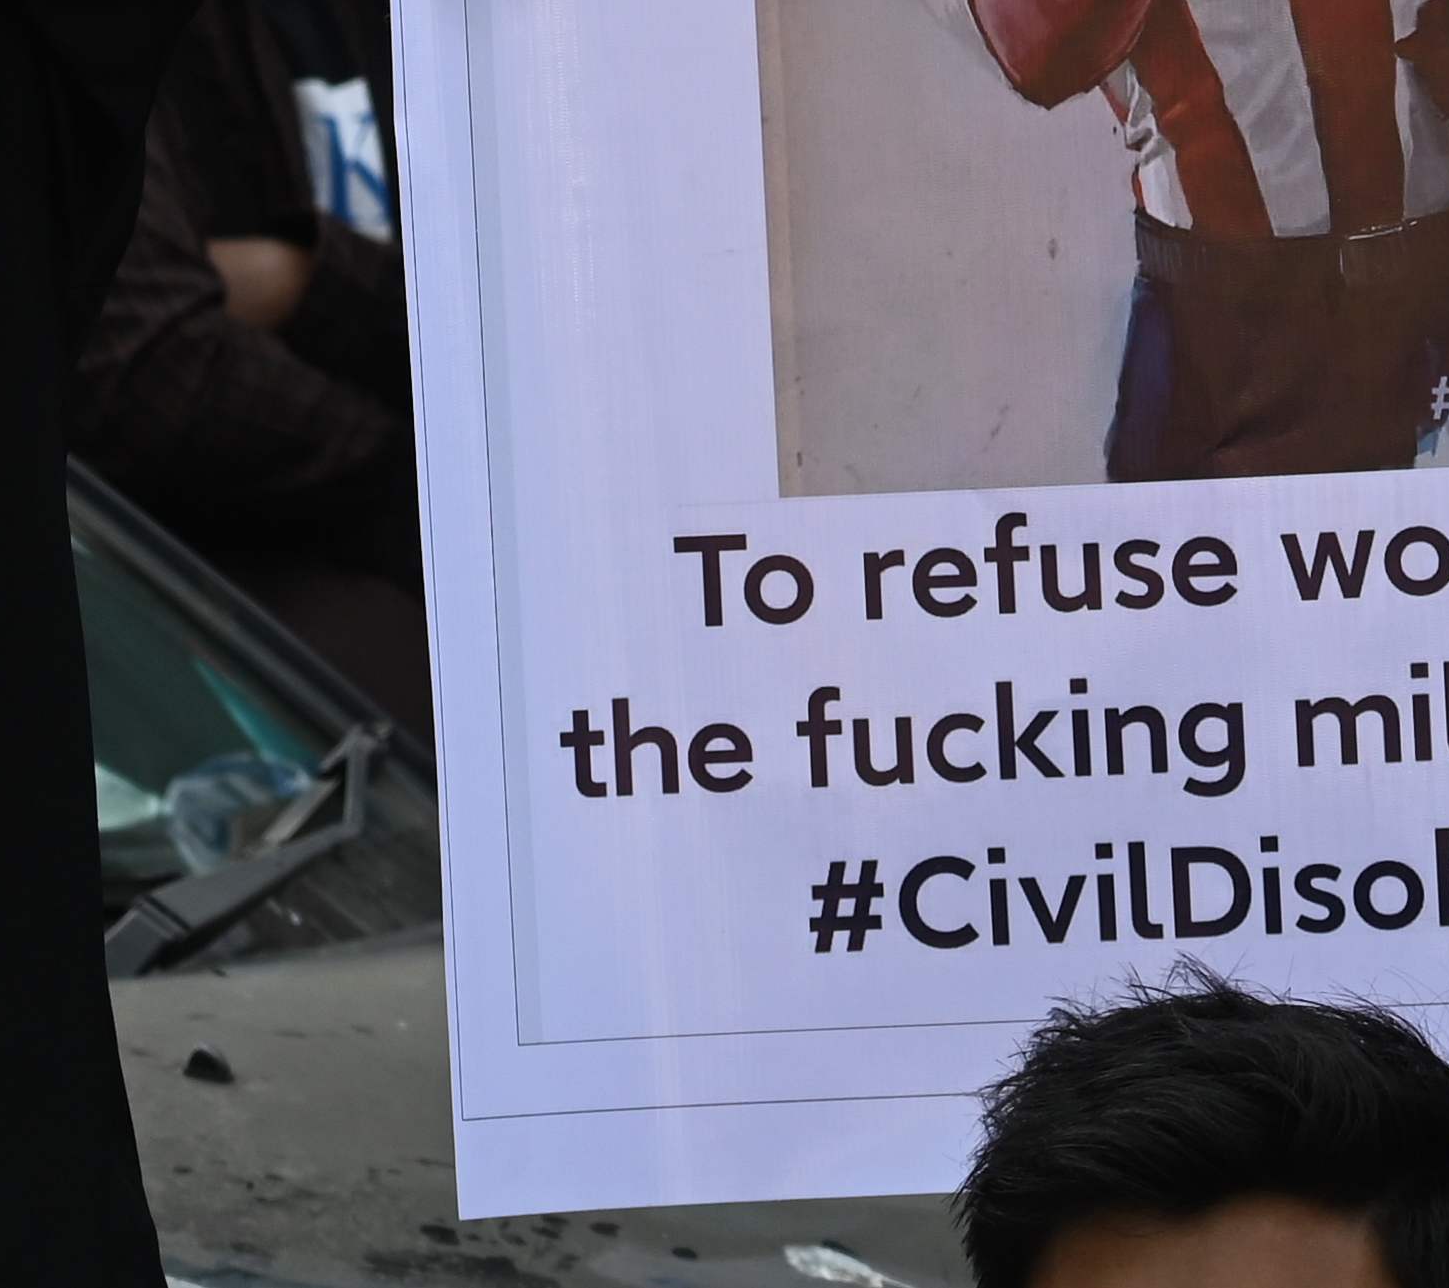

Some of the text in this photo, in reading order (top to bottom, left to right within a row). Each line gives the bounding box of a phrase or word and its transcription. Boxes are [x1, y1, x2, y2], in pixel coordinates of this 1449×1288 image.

[673, 534, 814, 627] To
[863, 512, 1237, 620] refuse
[560, 698, 753, 797] the
[796, 678, 1245, 797] fucking
